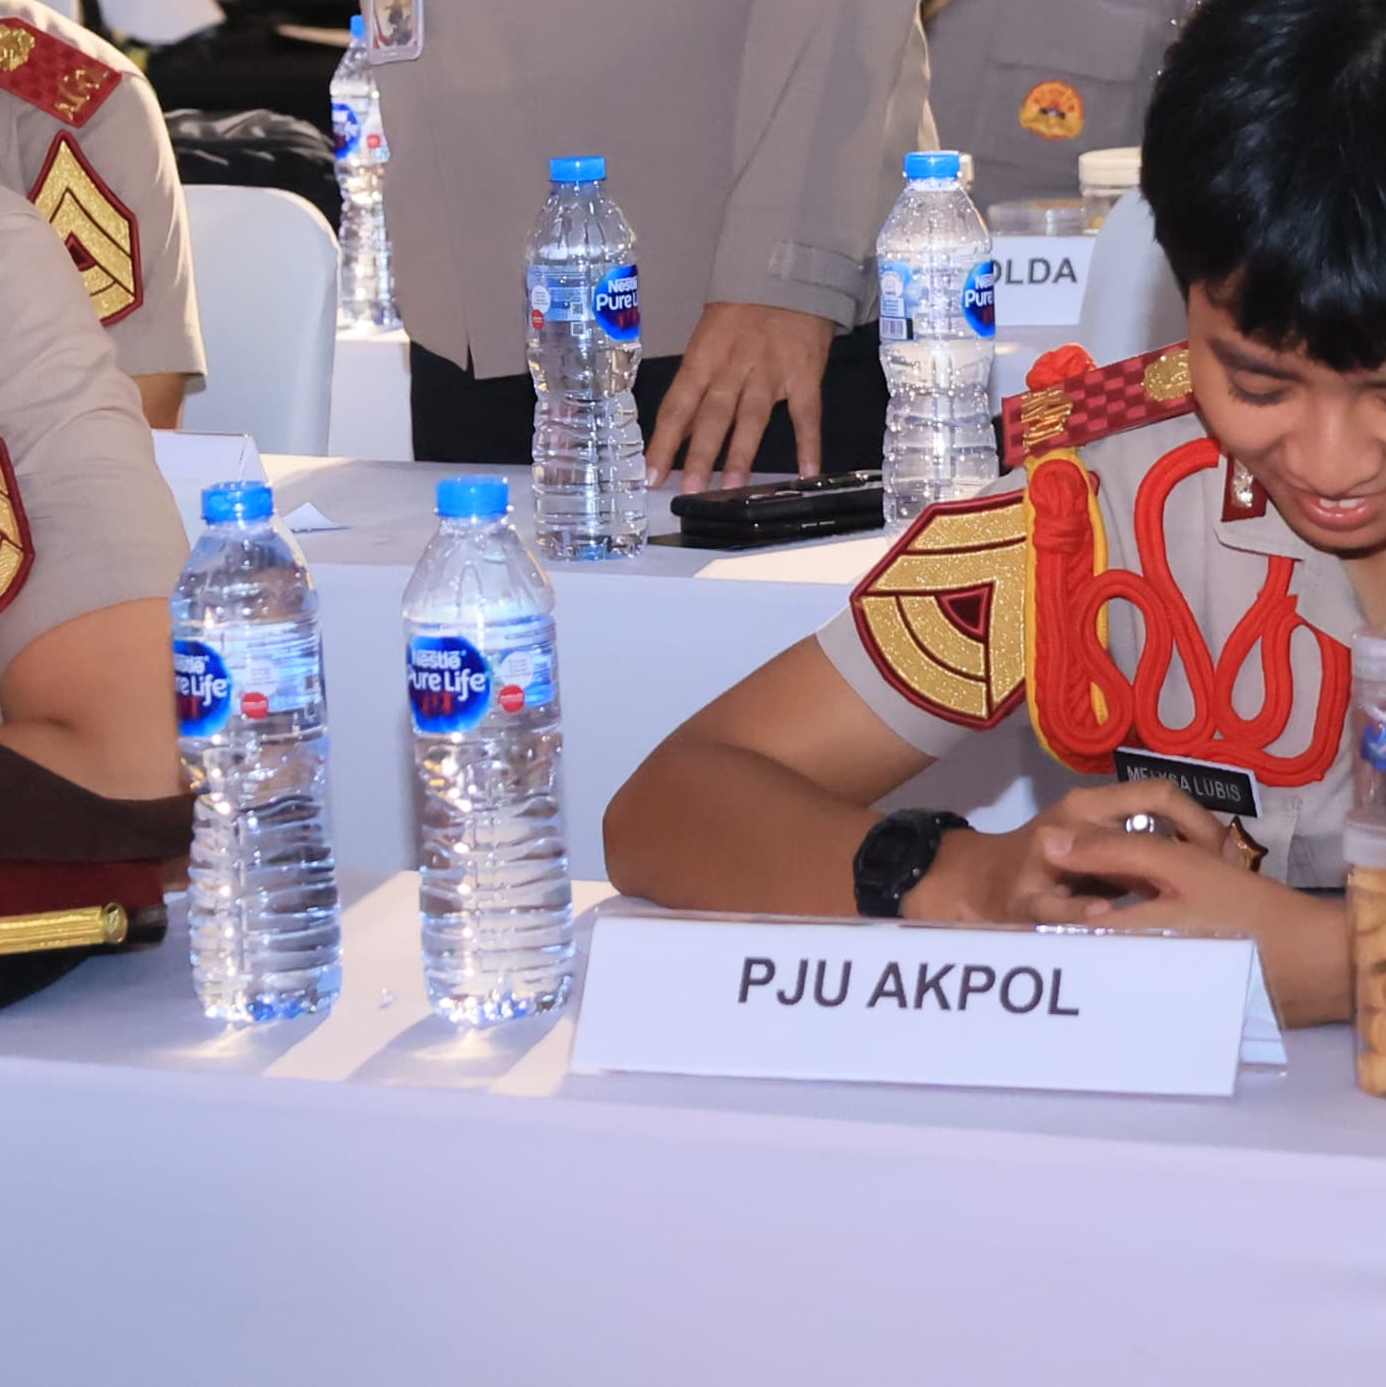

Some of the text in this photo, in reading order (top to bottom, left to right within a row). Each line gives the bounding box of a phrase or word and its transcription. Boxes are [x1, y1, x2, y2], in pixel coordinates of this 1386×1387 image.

[608, 277, 637, 293] Nestl
[990, 257, 1078, 285] OLDA
[596, 293, 631, 311] Pure
[191, 674, 228, 706] Life
[444, 669, 486, 702] Life
[1193, 774, 1241, 802] LUBIS
[738, 957, 1080, 1016] PJU AKPOL
